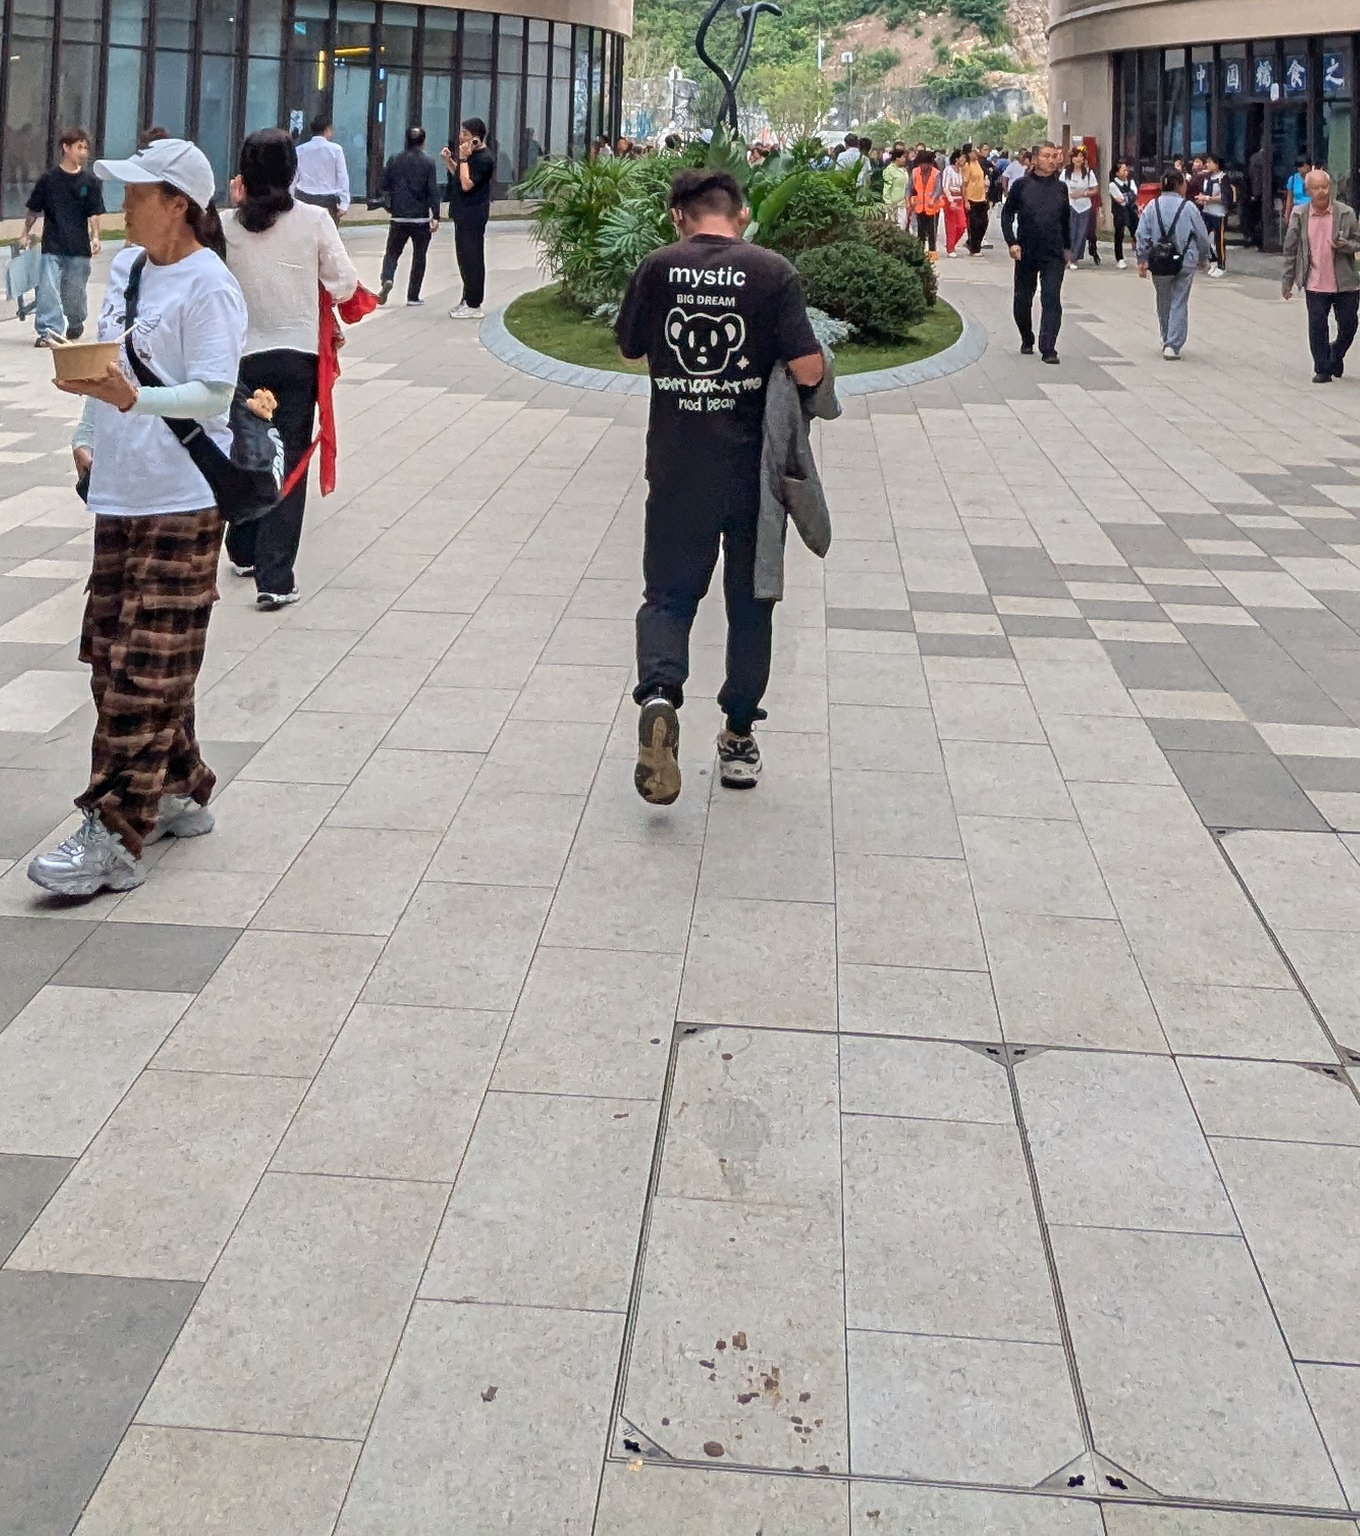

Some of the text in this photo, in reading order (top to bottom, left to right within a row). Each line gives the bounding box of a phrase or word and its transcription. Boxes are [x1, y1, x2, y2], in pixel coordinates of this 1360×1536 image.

[668, 266, 747, 289] mystic
[676, 293, 736, 307] BIG DREAM
